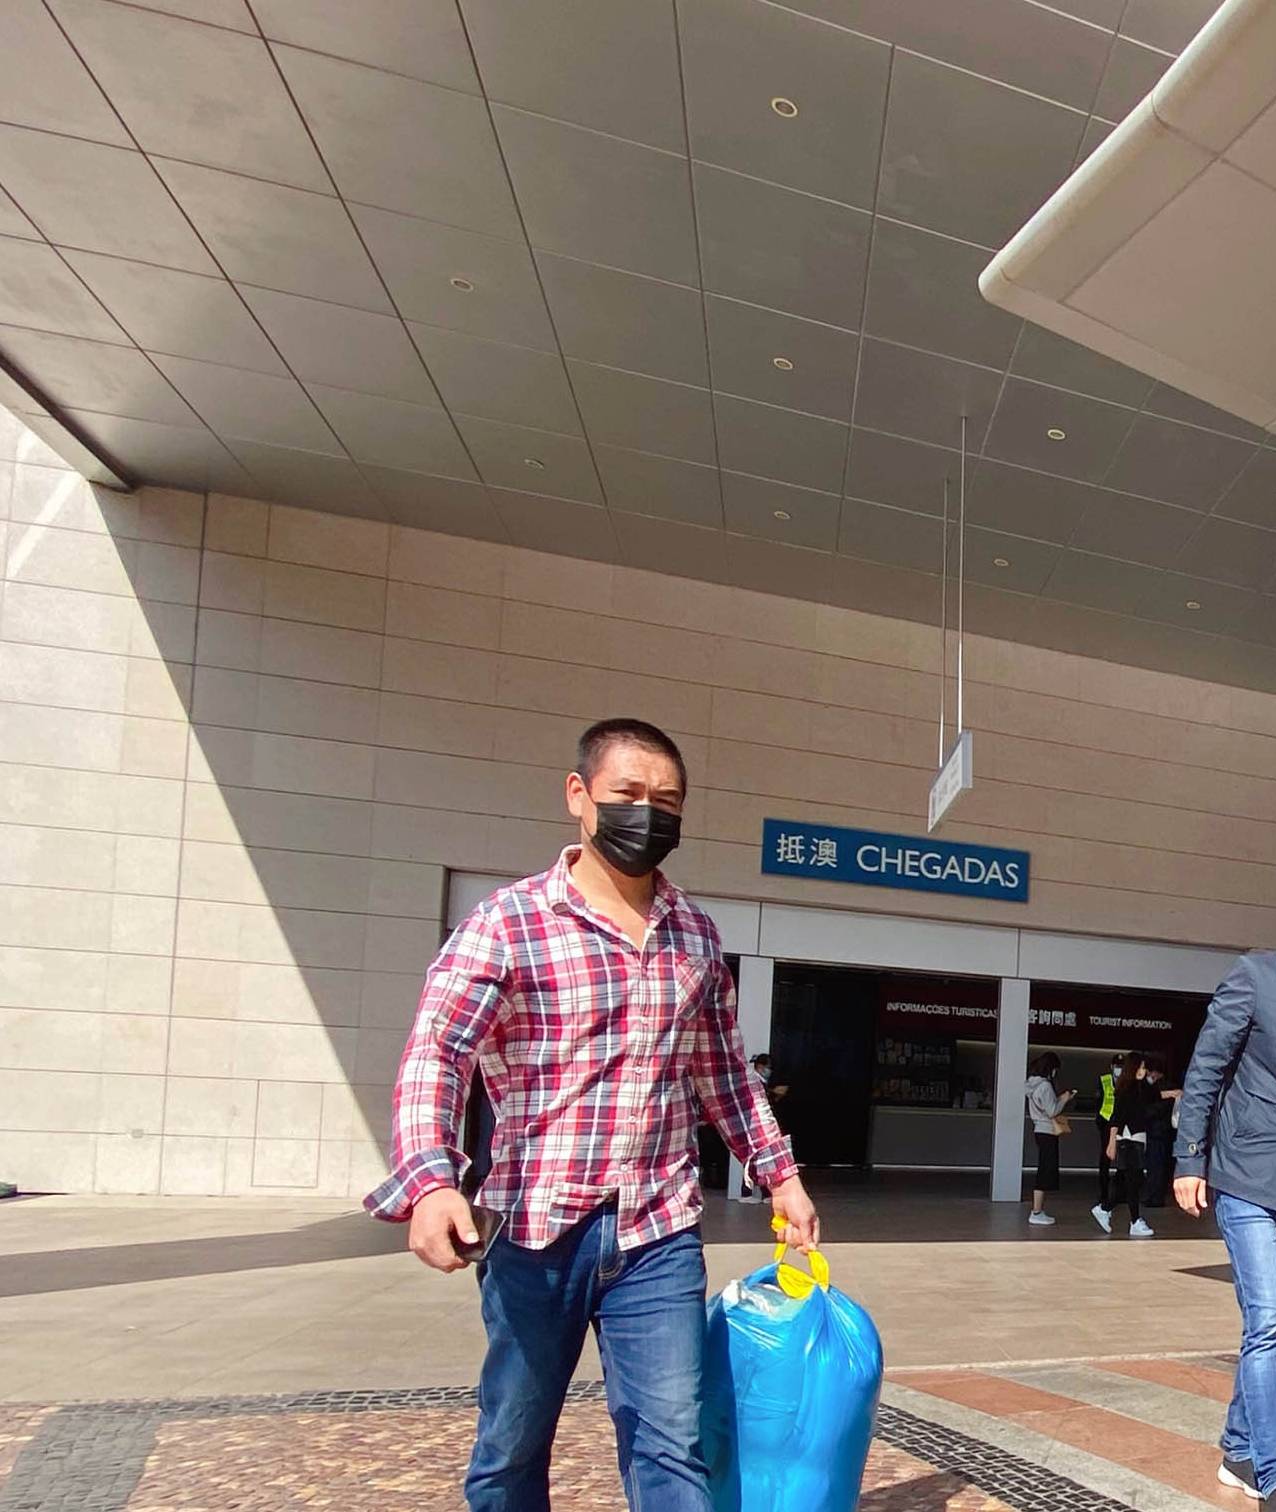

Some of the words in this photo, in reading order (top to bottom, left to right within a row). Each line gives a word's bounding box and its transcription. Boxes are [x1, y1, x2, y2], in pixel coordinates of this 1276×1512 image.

[776, 833, 838, 869] 抵澳
[856, 845, 1019, 888] CHEGADAS
[1089, 1015, 1121, 1027] TOURIST
[1122, 1018, 1173, 1030] INFORMATION
